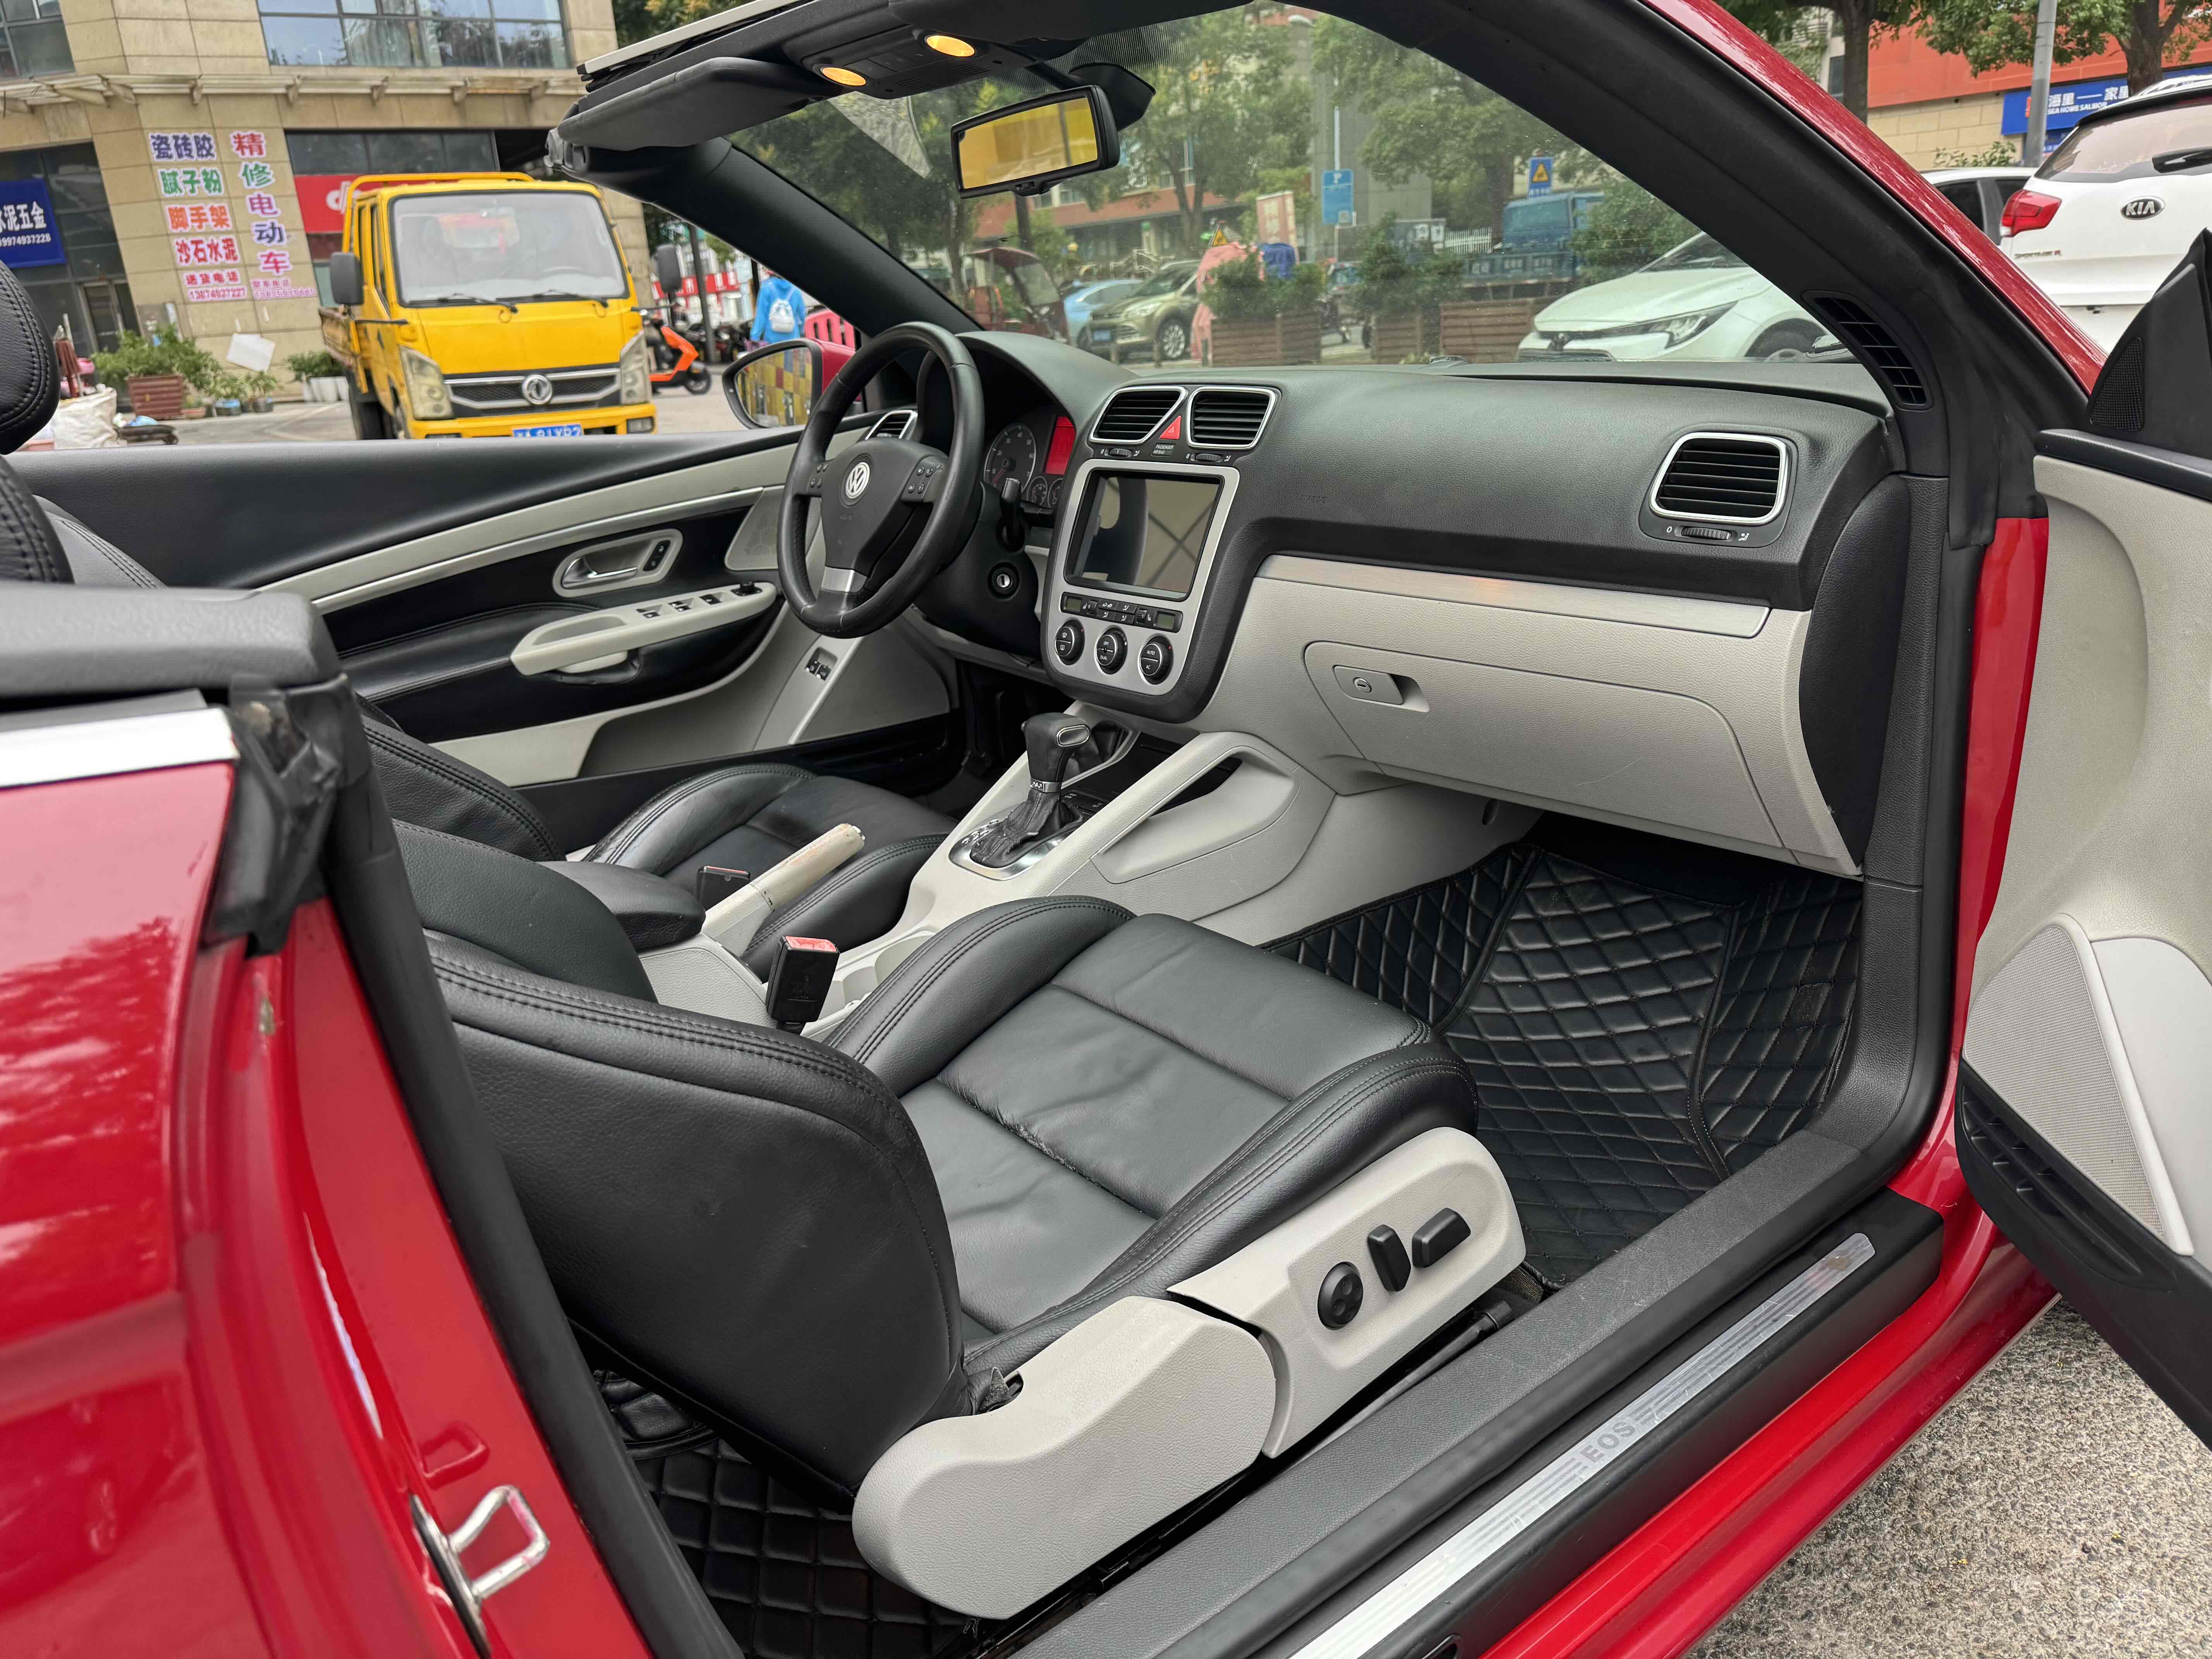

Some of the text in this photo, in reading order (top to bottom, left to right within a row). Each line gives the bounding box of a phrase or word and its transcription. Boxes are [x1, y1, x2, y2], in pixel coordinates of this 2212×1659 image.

[151, 134, 215, 159] 瓷砖胶
[160, 168, 222, 195] 腻子粉
[167, 205, 230, 230] 脚手架
[2126, 201, 2155, 216] KIA
[175, 237, 239, 264] 沙石水泥
[1580, 1422, 1636, 1463] EOS
